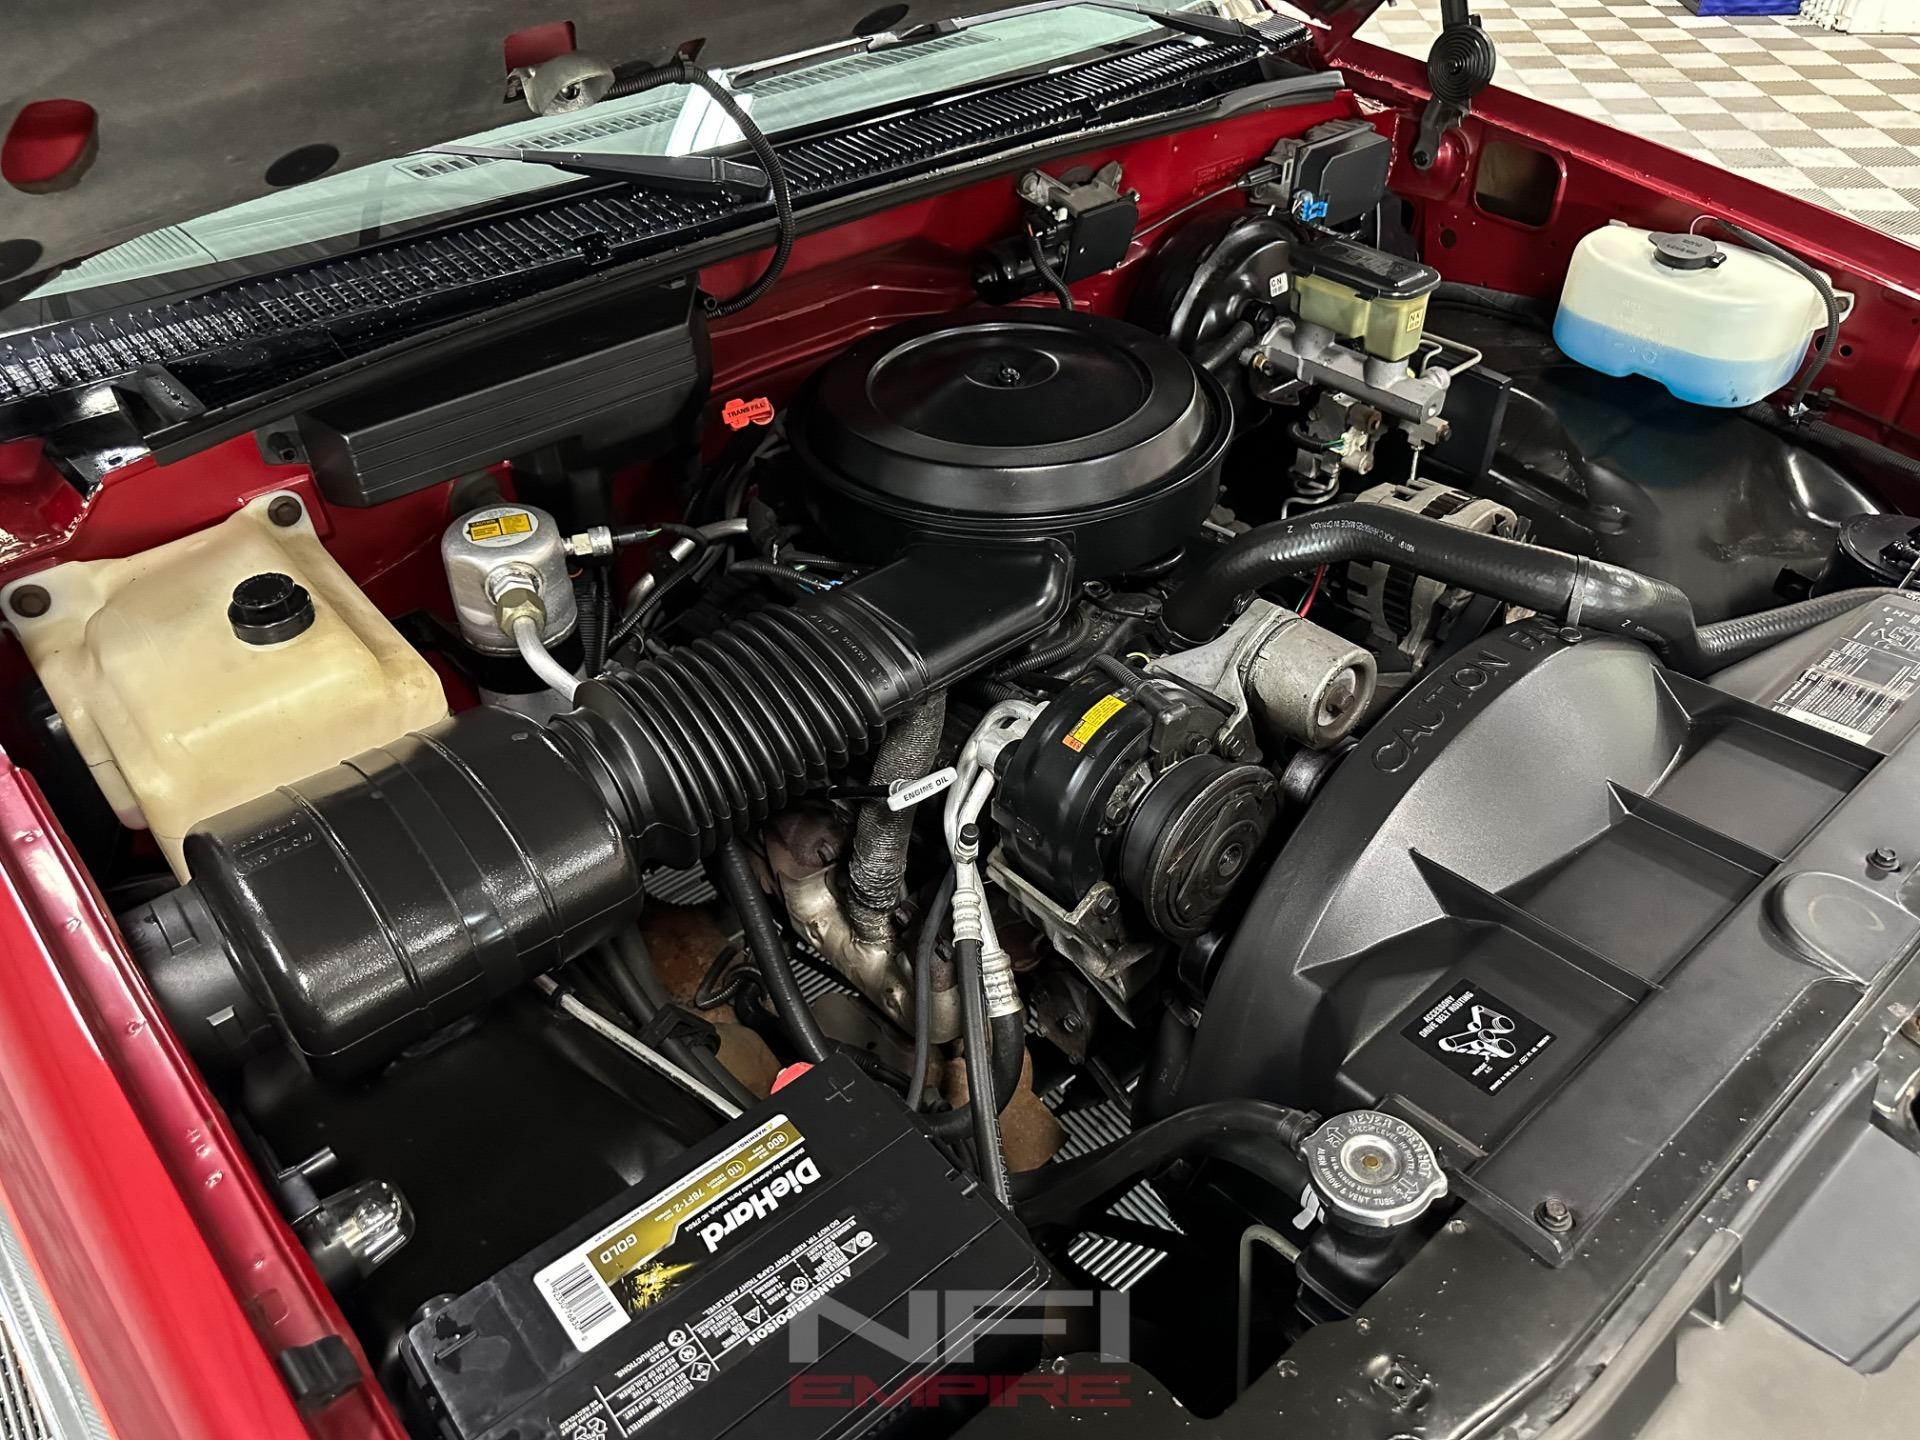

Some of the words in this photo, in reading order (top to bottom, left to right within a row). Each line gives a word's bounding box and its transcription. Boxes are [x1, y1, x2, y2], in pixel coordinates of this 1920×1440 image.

[727, 406, 750, 418] TRANS
[750, 401, 766, 411] FILL
[1309, 520, 1333, 528] CANADA
[1371, 649, 1511, 773] CAUTION
[903, 782, 934, 802] ENGINE
[935, 776, 949, 787] OIL
[1418, 1020, 1438, 1038] DRIVE
[1434, 1009, 1451, 1025] BELT
[1448, 989, 1474, 1013] ROUTING
[1422, 994, 1455, 1023] ACCESSORY
[737, 1126, 767, 1150] WARNING:
[765, 1132, 785, 1150] 800
[1325, 1136, 1340, 1148] AC
[1347, 1113, 1393, 1127] NEVER
[1396, 1125, 1425, 1153] OPEN
[1416, 1153, 1432, 1179] HOT
[1347, 1125, 1375, 1134] CHECK
[1375, 1126, 1397, 1142] LEVEL
[1398, 1141, 1407, 1149] IN
[1404, 1149, 1414, 1175] BOTTLE
[726, 1162, 743, 1177] 110
[751, 1168, 773, 1185] Advance
[1316, 1147, 1325, 1166] ALIGN
[1321, 1166, 1340, 1188] ARROW
[1348, 1191, 1369, 1203] VENT
[1374, 1197, 1395, 1205] TUBE
[740, 1181, 753, 1193] Auto
[1356, 1184, 1382, 1194] SYSTEM
[700, 1211, 709, 1221] NC
[828, 1218, 840, 1228] DO
[816, 1225, 831, 1237] NOT
[597, 1231, 639, 1265] GOLD
[789, 1241, 807, 1256] KEEP
[822, 1236, 831, 1244] OR
[823, 1240, 836, 1252] CAN
[773, 1252, 791, 1268] VENT
[808, 1248, 825, 1262] CAUSE
[813, 1250, 844, 1274] EXPLOSIVE
[821, 1245, 840, 1262] GASES
[828, 1255, 848, 1271] SHIELD
[756, 1264, 775, 1280] CAPS
[737, 1276, 757, 1293] TIGHT
[753, 1275, 777, 1295] SMOKING
[760, 1280, 782, 1299] FLAMES
[723, 1288, 739, 1301] AND
[766, 1287, 787, 1305] SPARKS
[784, 1291, 795, 1302] NO
[701, 1298, 726, 1317] LEVEL.
[713, 1304, 734, 1322] SEVERE
[745, 1271, 844, 1346] DANGER/POISON
[694, 1317, 715, 1335] BURNS.
[708, 1309, 738, 1333] BLINDNESS
[729, 1314, 742, 1326] CAN
[730, 1320, 746, 1333] ACID
[700, 1328, 711, 1338] OR
[712, 1322, 731, 1337] CAUSE
[720, 1325, 750, 1348] SULFURIC
[613, 1340, 666, 1379] INSTRUCTIONS.
[648, 1346, 669, 1363] READ
[654, 1356, 676, 1374] REACH
[663, 1361, 680, 1376] KEEP
[646, 1369, 656, 1379] OF
[650, 1371, 665, 1384] OUT
[673, 1371, 686, 1383] GET
[616, 1374, 648, 1400] CHILDREN.
[629, 1386, 643, 1398] THE
[641, 1380, 652, 1390] OF
[650, 1379, 675, 1399] MEDICAL
[674, 1377, 690, 1391] WITH
[674, 1382, 694, 1399] FLUSH
[588, 1399, 599, 1408] BE
[636, 1395, 652, 1408] HELP
[654, 1387, 675, 1405] WATER.
[660, 1395, 676, 1408] EYES
[558, 1405, 590, 1429] RECYCLED
[576, 1402, 603, 1424] BATTERY
[621, 1404, 639, 1420] FAST.
[625, 1404, 663, 1434] IMMEDIATELY
[559, 1421, 578, 1436] MUST
